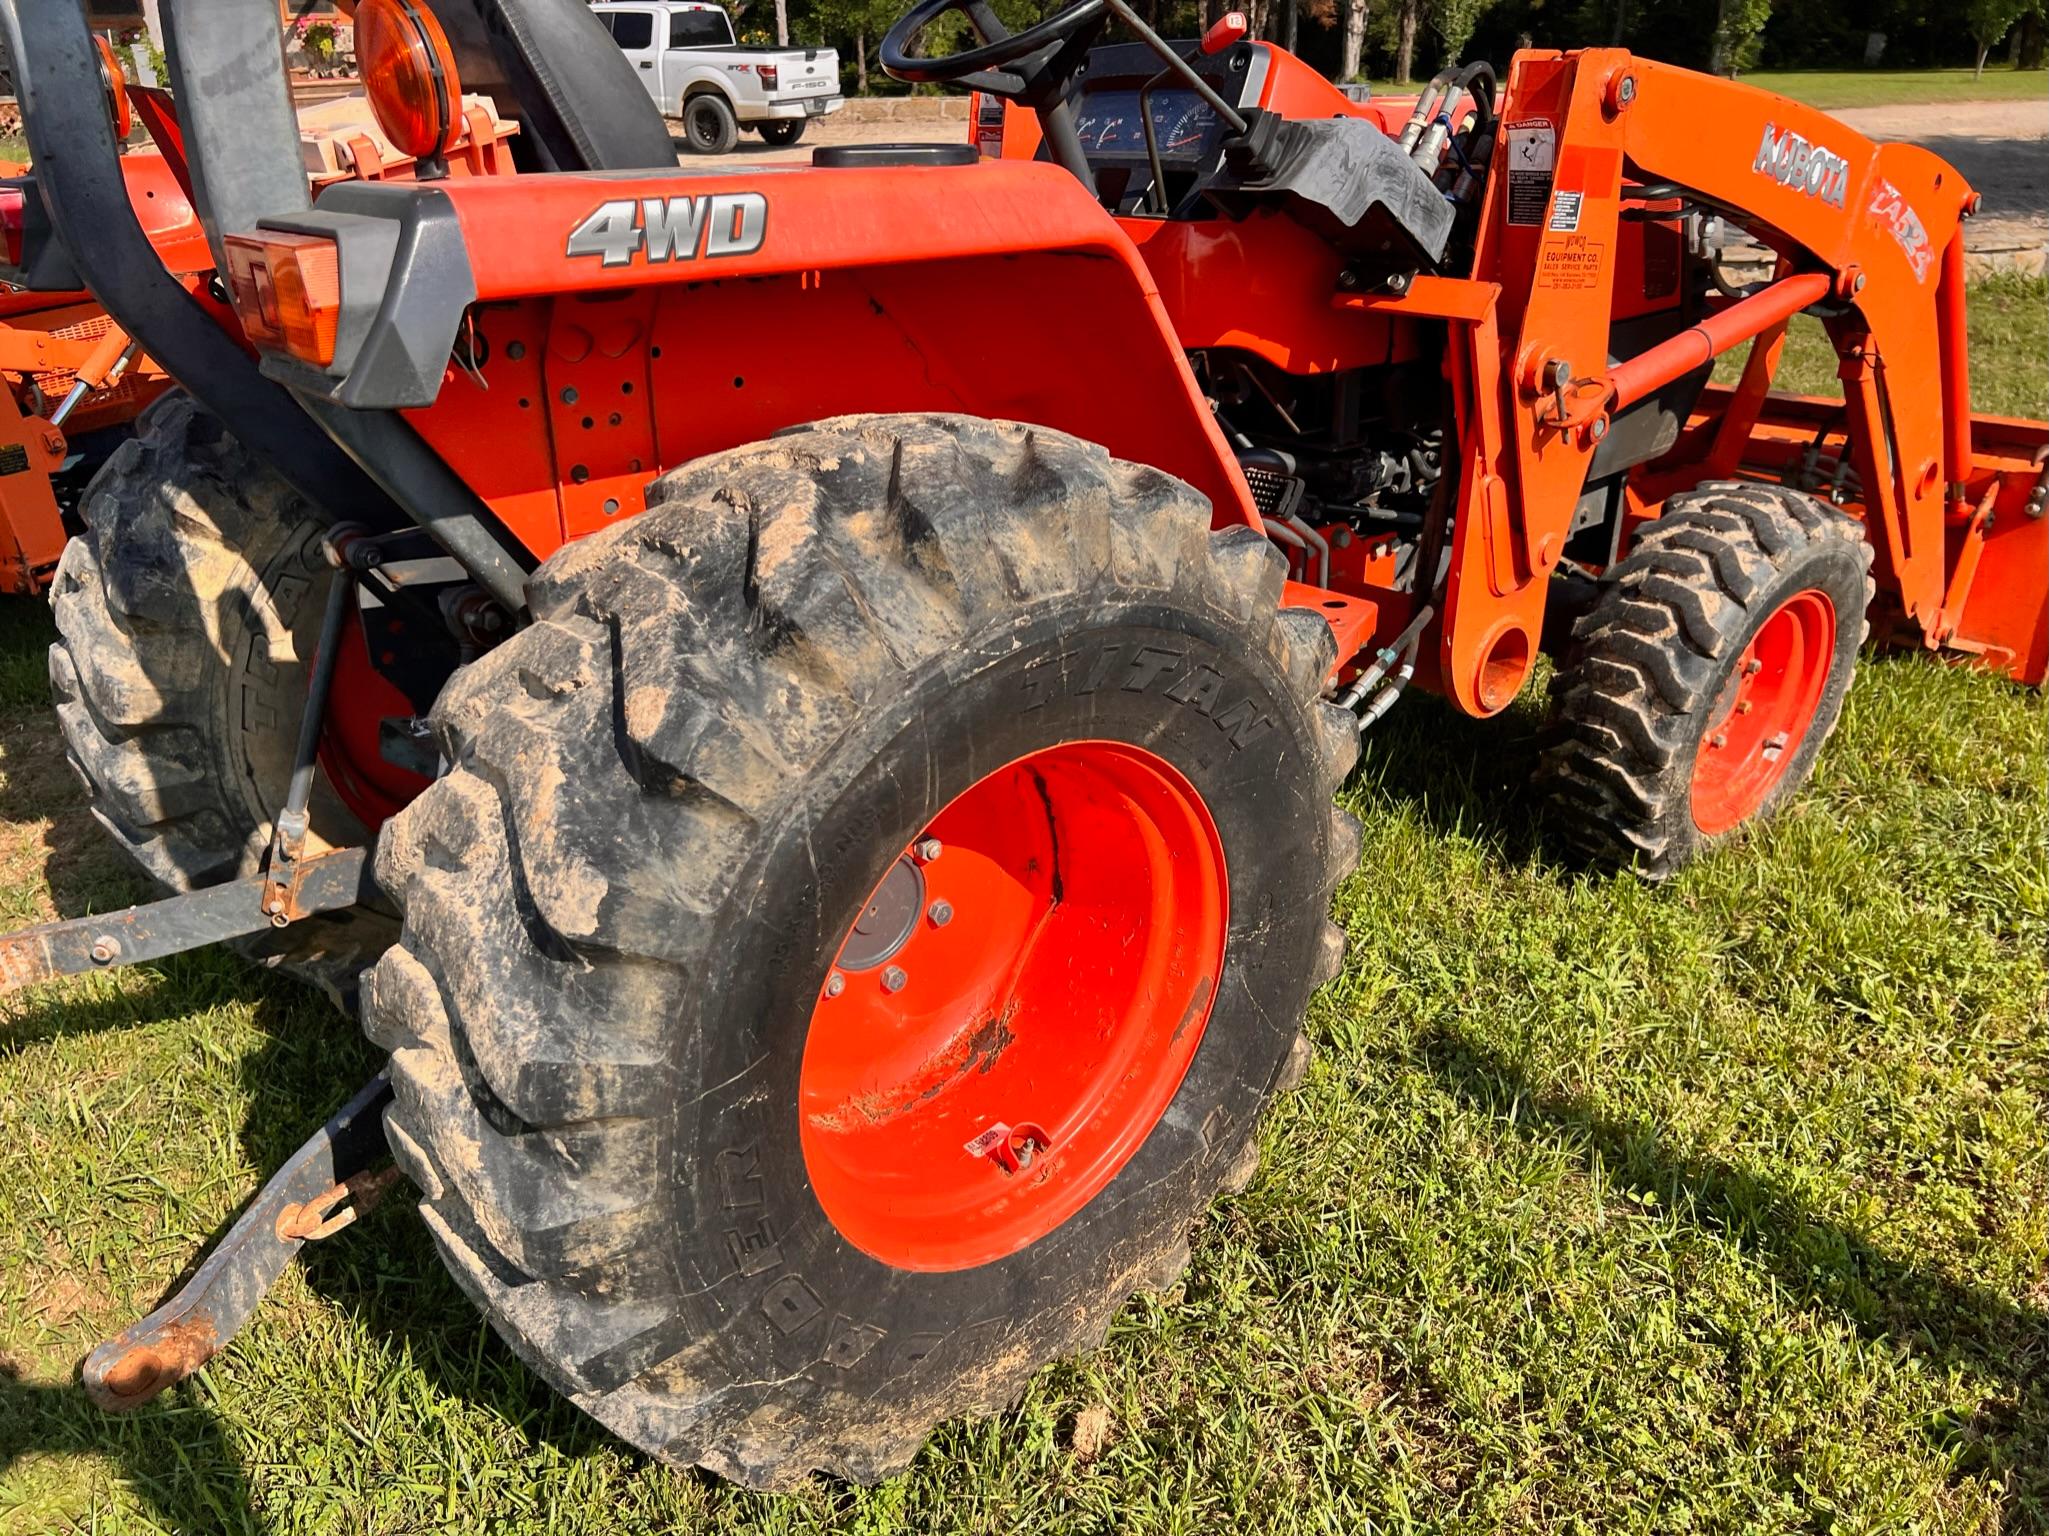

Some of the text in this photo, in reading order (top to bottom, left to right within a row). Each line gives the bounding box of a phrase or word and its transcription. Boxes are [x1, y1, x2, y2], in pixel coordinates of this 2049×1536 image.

[792, 81, 827, 90] F-150
[1516, 120, 1549, 129] DANGER
[1752, 121, 1850, 210] KUBOTA
[565, 191, 769, 268] 4WD
[1546, 252, 1587, 262] EQUIPMENT
[1869, 188, 1935, 284] LA524
[1020, 645, 1275, 751] TITAN
